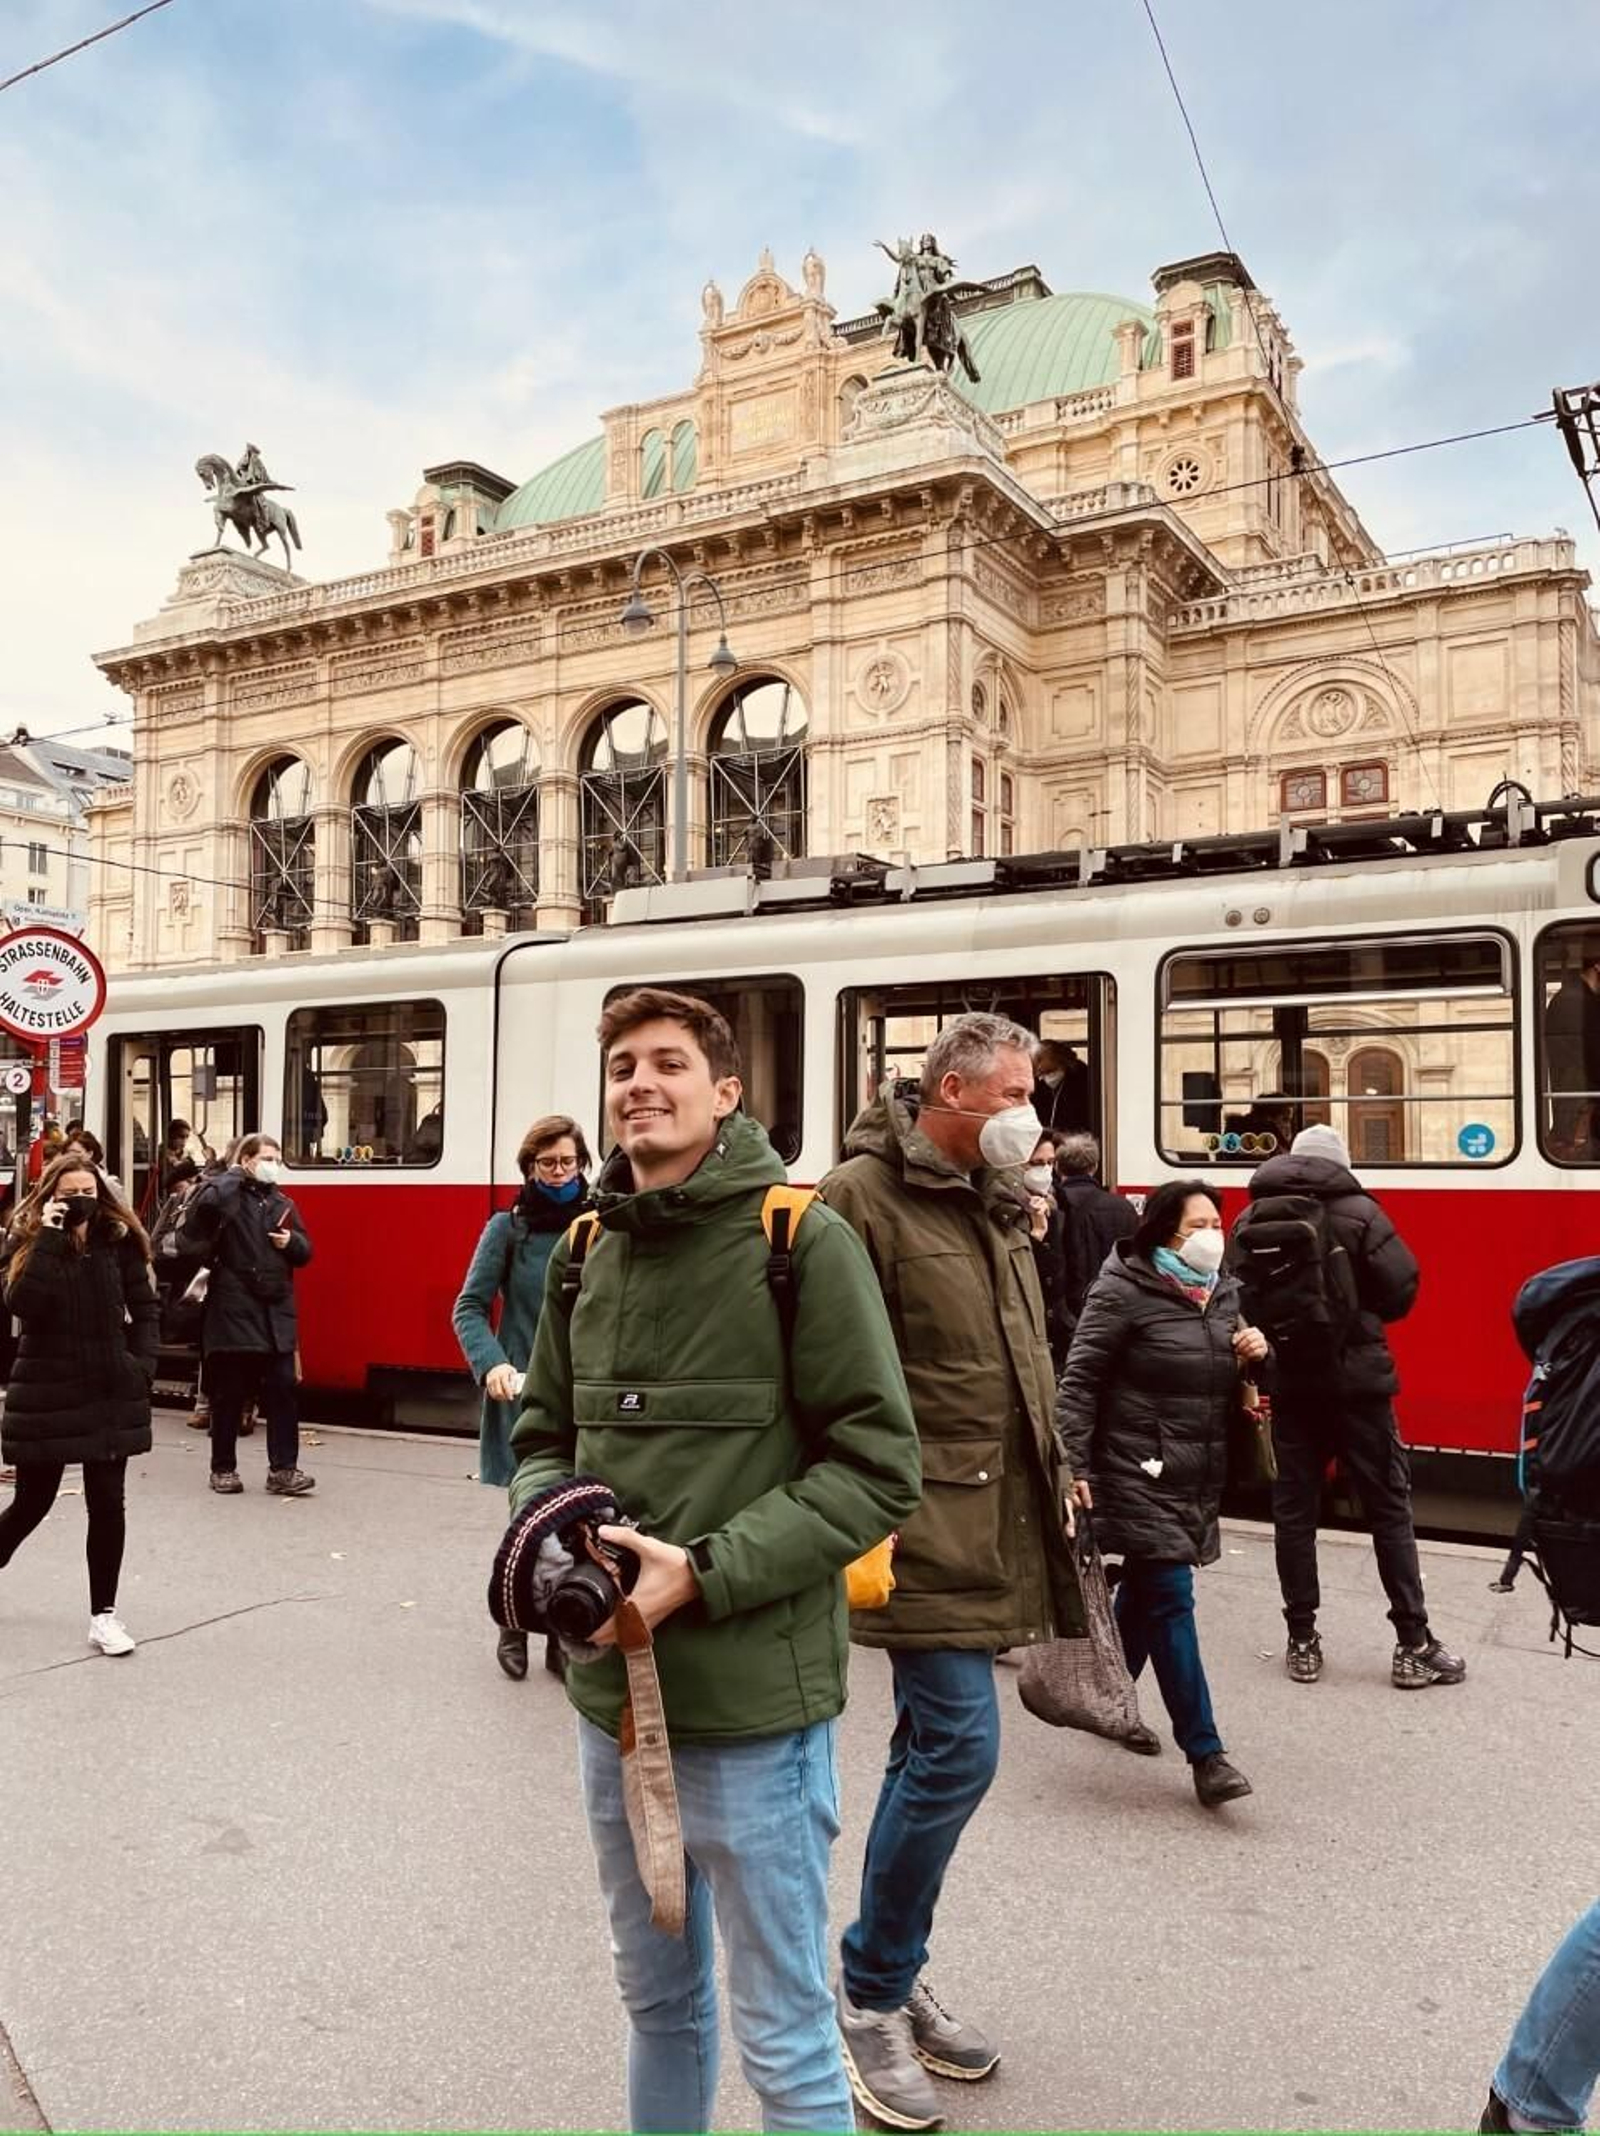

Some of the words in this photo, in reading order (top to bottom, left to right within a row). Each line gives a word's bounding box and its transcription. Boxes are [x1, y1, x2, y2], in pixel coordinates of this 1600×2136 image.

[0, 942, 91, 984] STRASSENBAHN
[0, 992, 85, 1028] HALTESTELLE
[13, 1073, 23, 1087] 2
